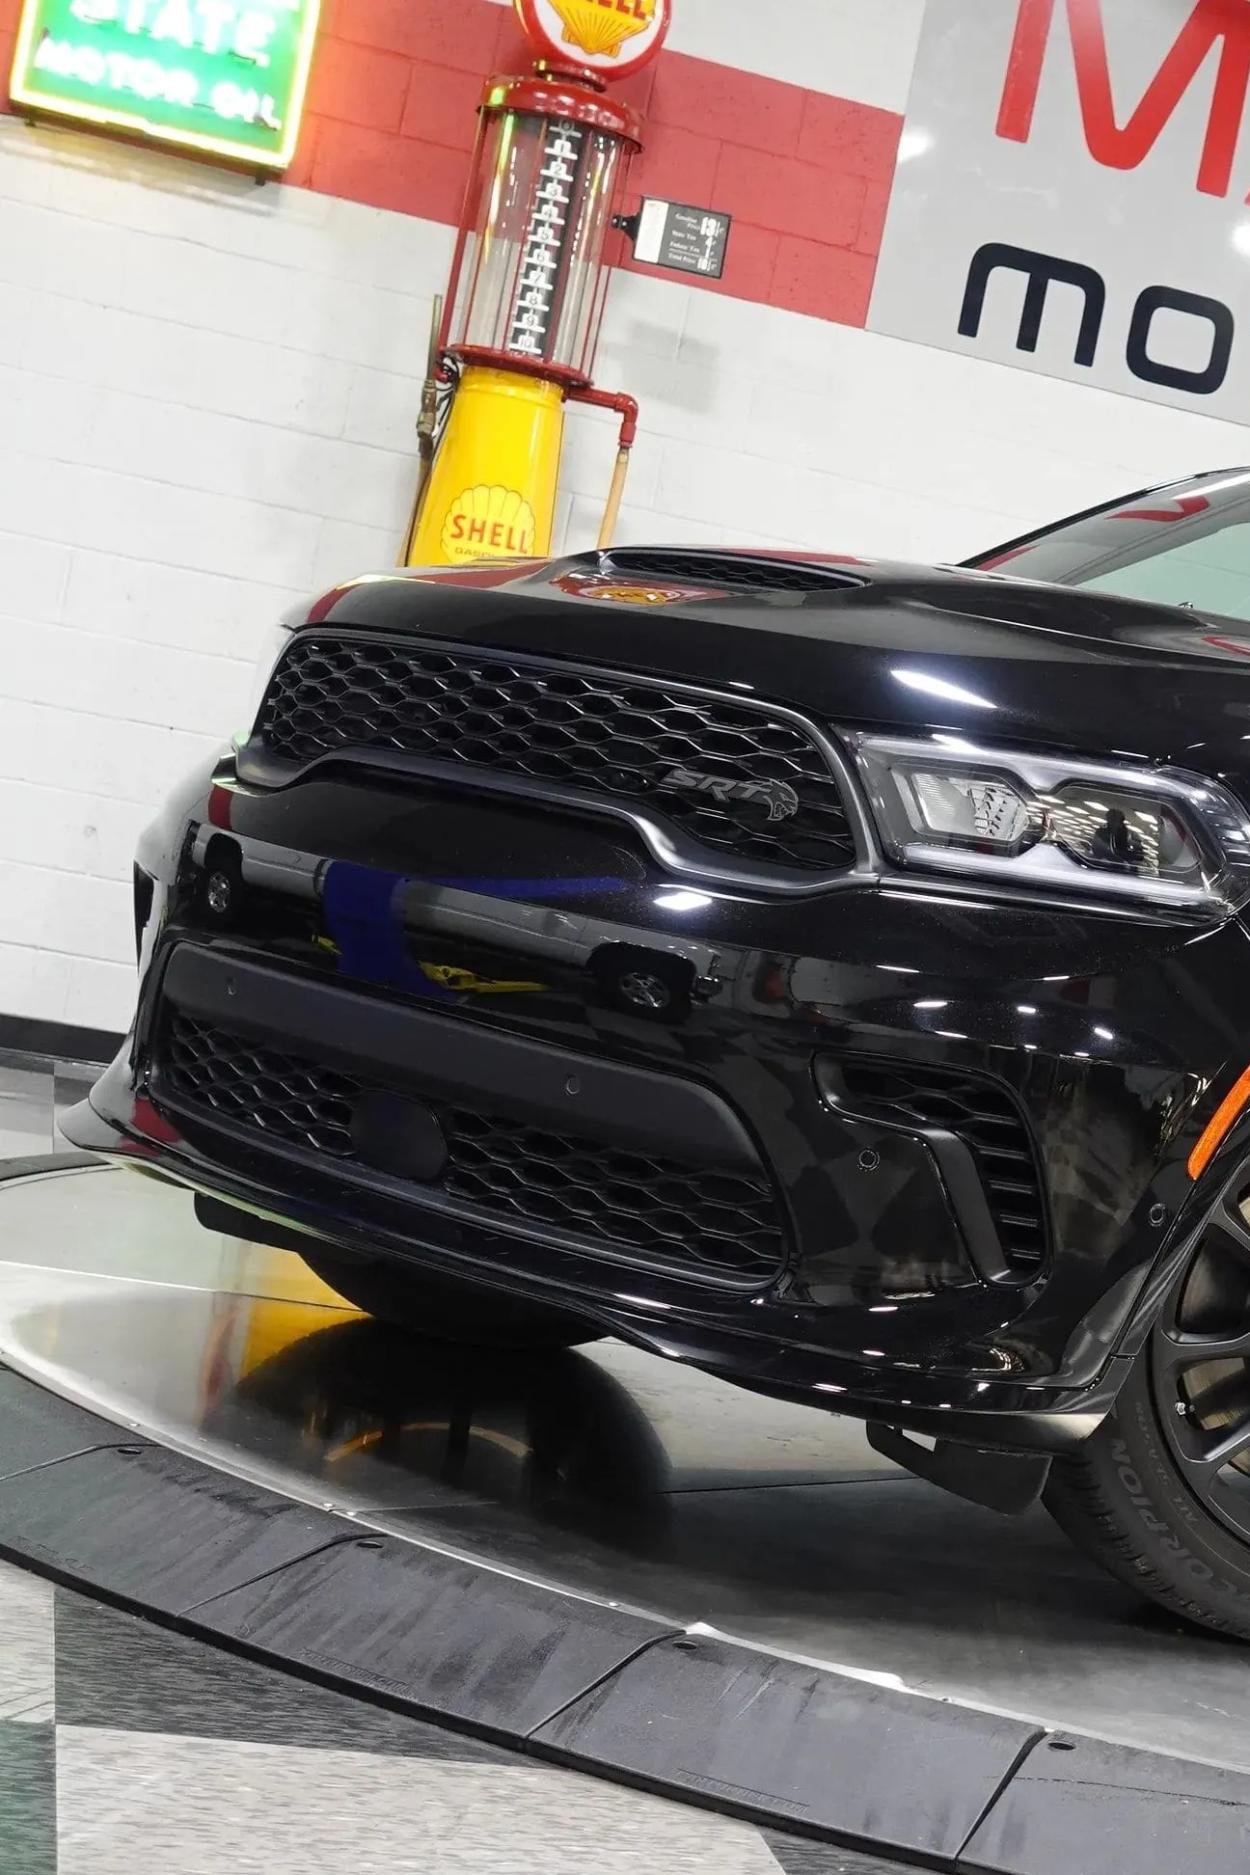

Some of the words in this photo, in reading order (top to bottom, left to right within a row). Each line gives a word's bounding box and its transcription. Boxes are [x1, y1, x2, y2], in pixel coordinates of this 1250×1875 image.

[34, 33, 201, 109] MOTOR
[208, 80, 284, 132] OIL
[450, 513, 528, 555] SHELL
[659, 768, 774, 804] SRT
